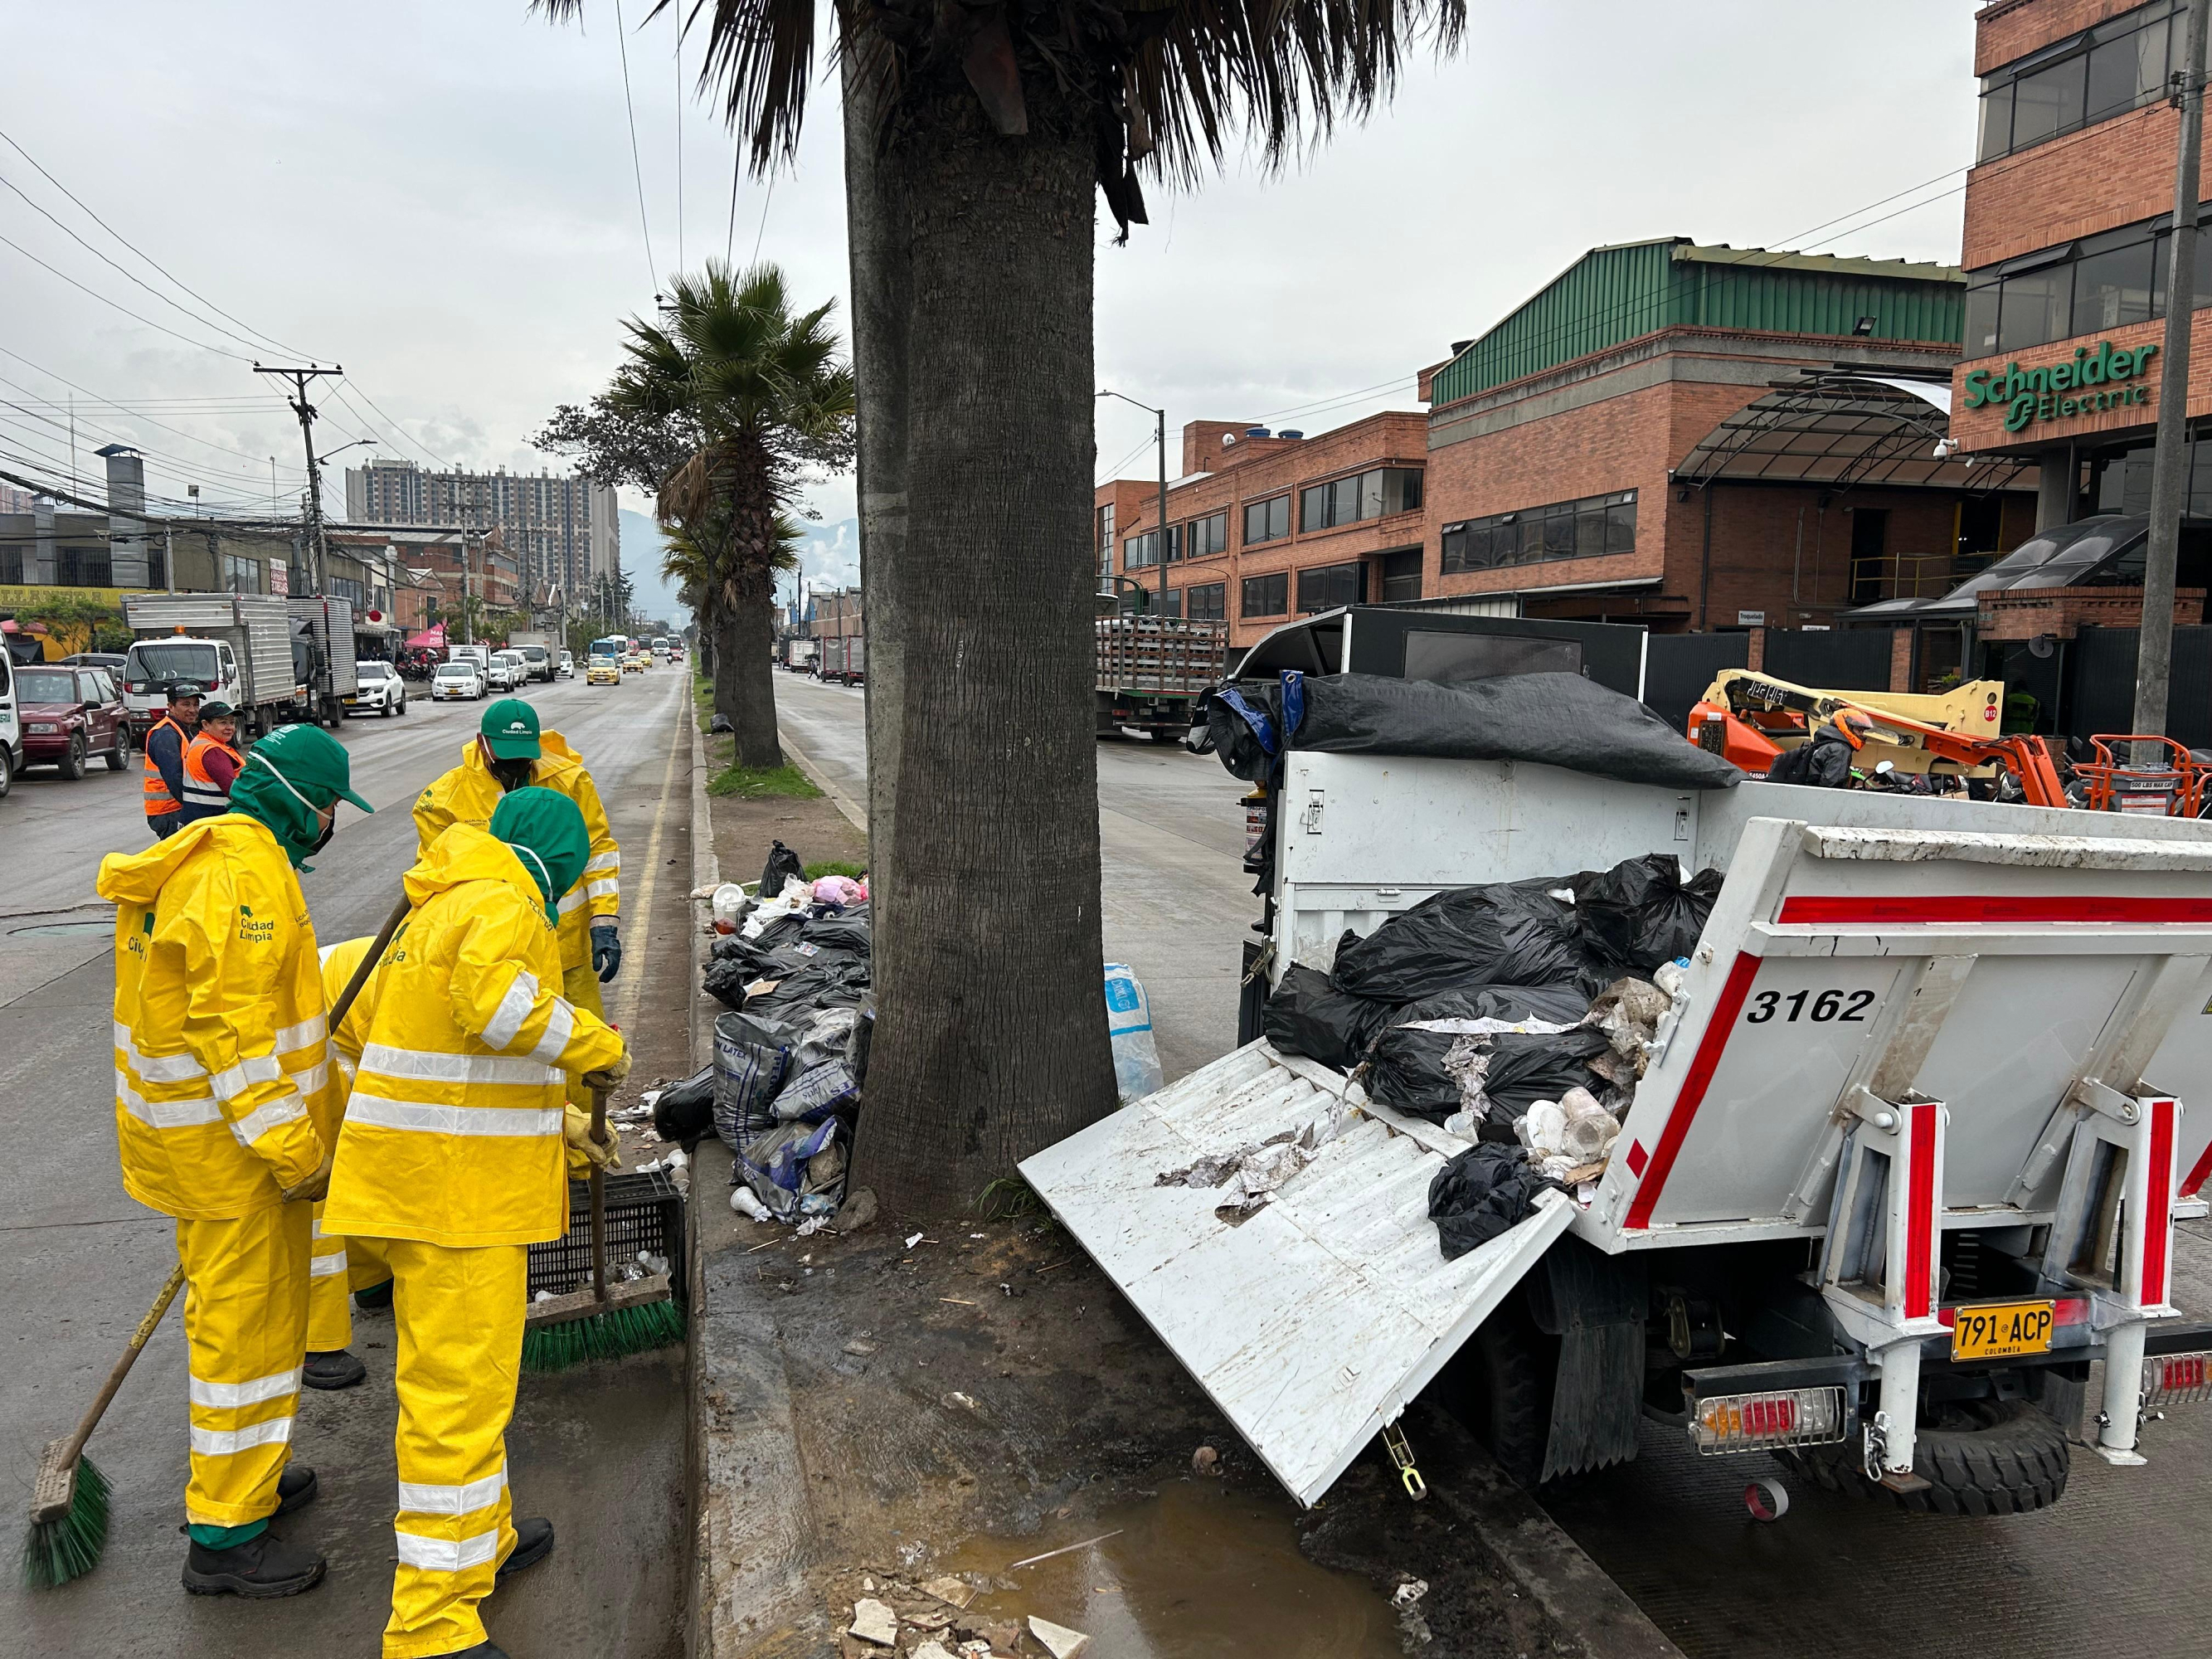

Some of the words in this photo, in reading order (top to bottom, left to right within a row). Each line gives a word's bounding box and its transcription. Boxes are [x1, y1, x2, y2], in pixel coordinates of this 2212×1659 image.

[1964, 339, 2158, 408] Schneider
[2038, 382, 2150, 420] Electric
[1985, 709, 1996, 718] B12
[241, 918, 275, 931] Ciudad
[240, 929, 273, 944] Limpia
[1747, 989, 1876, 1024] 3162
[722, 1045, 747, 1060] LATEX
[1959, 1314, 1997, 1346] 791
[2009, 1310, 2051, 1343] ACP
[1985, 1345, 2021, 1355] COLOMBIA
